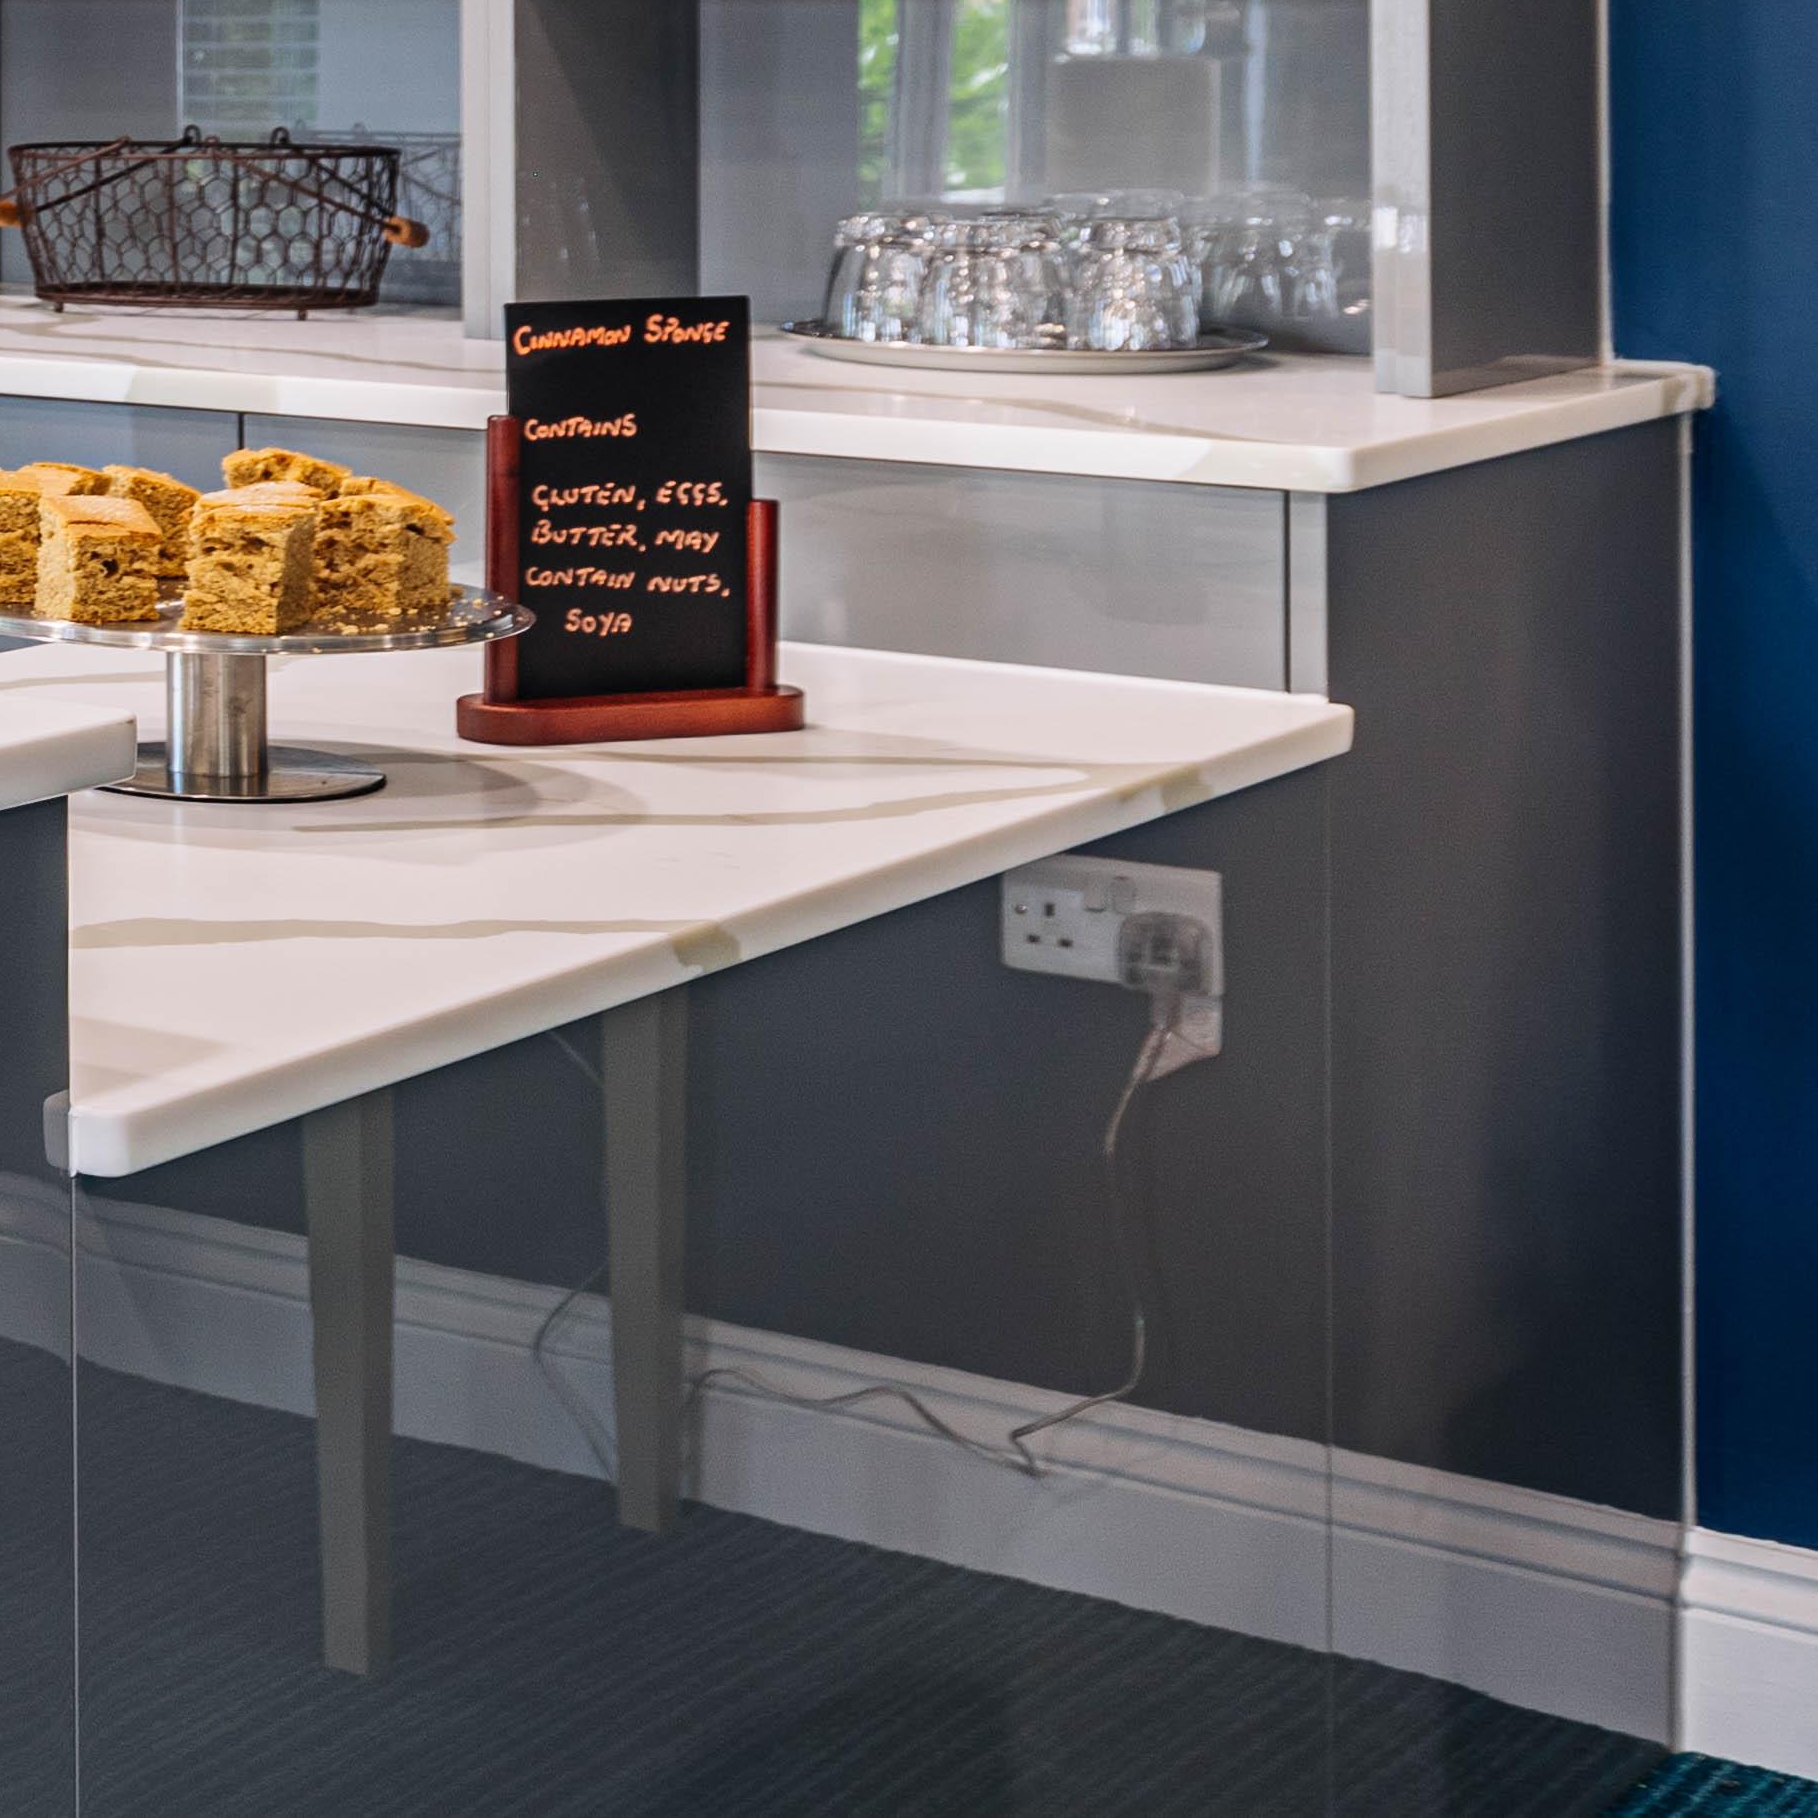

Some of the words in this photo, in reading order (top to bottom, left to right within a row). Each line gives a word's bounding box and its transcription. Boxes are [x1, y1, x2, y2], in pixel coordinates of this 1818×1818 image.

[523, 413, 638, 442] CONTAINS
[654, 528, 720, 554] MAY
[526, 566, 635, 589] CONTAIN
[564, 607, 633, 637] SOYA
